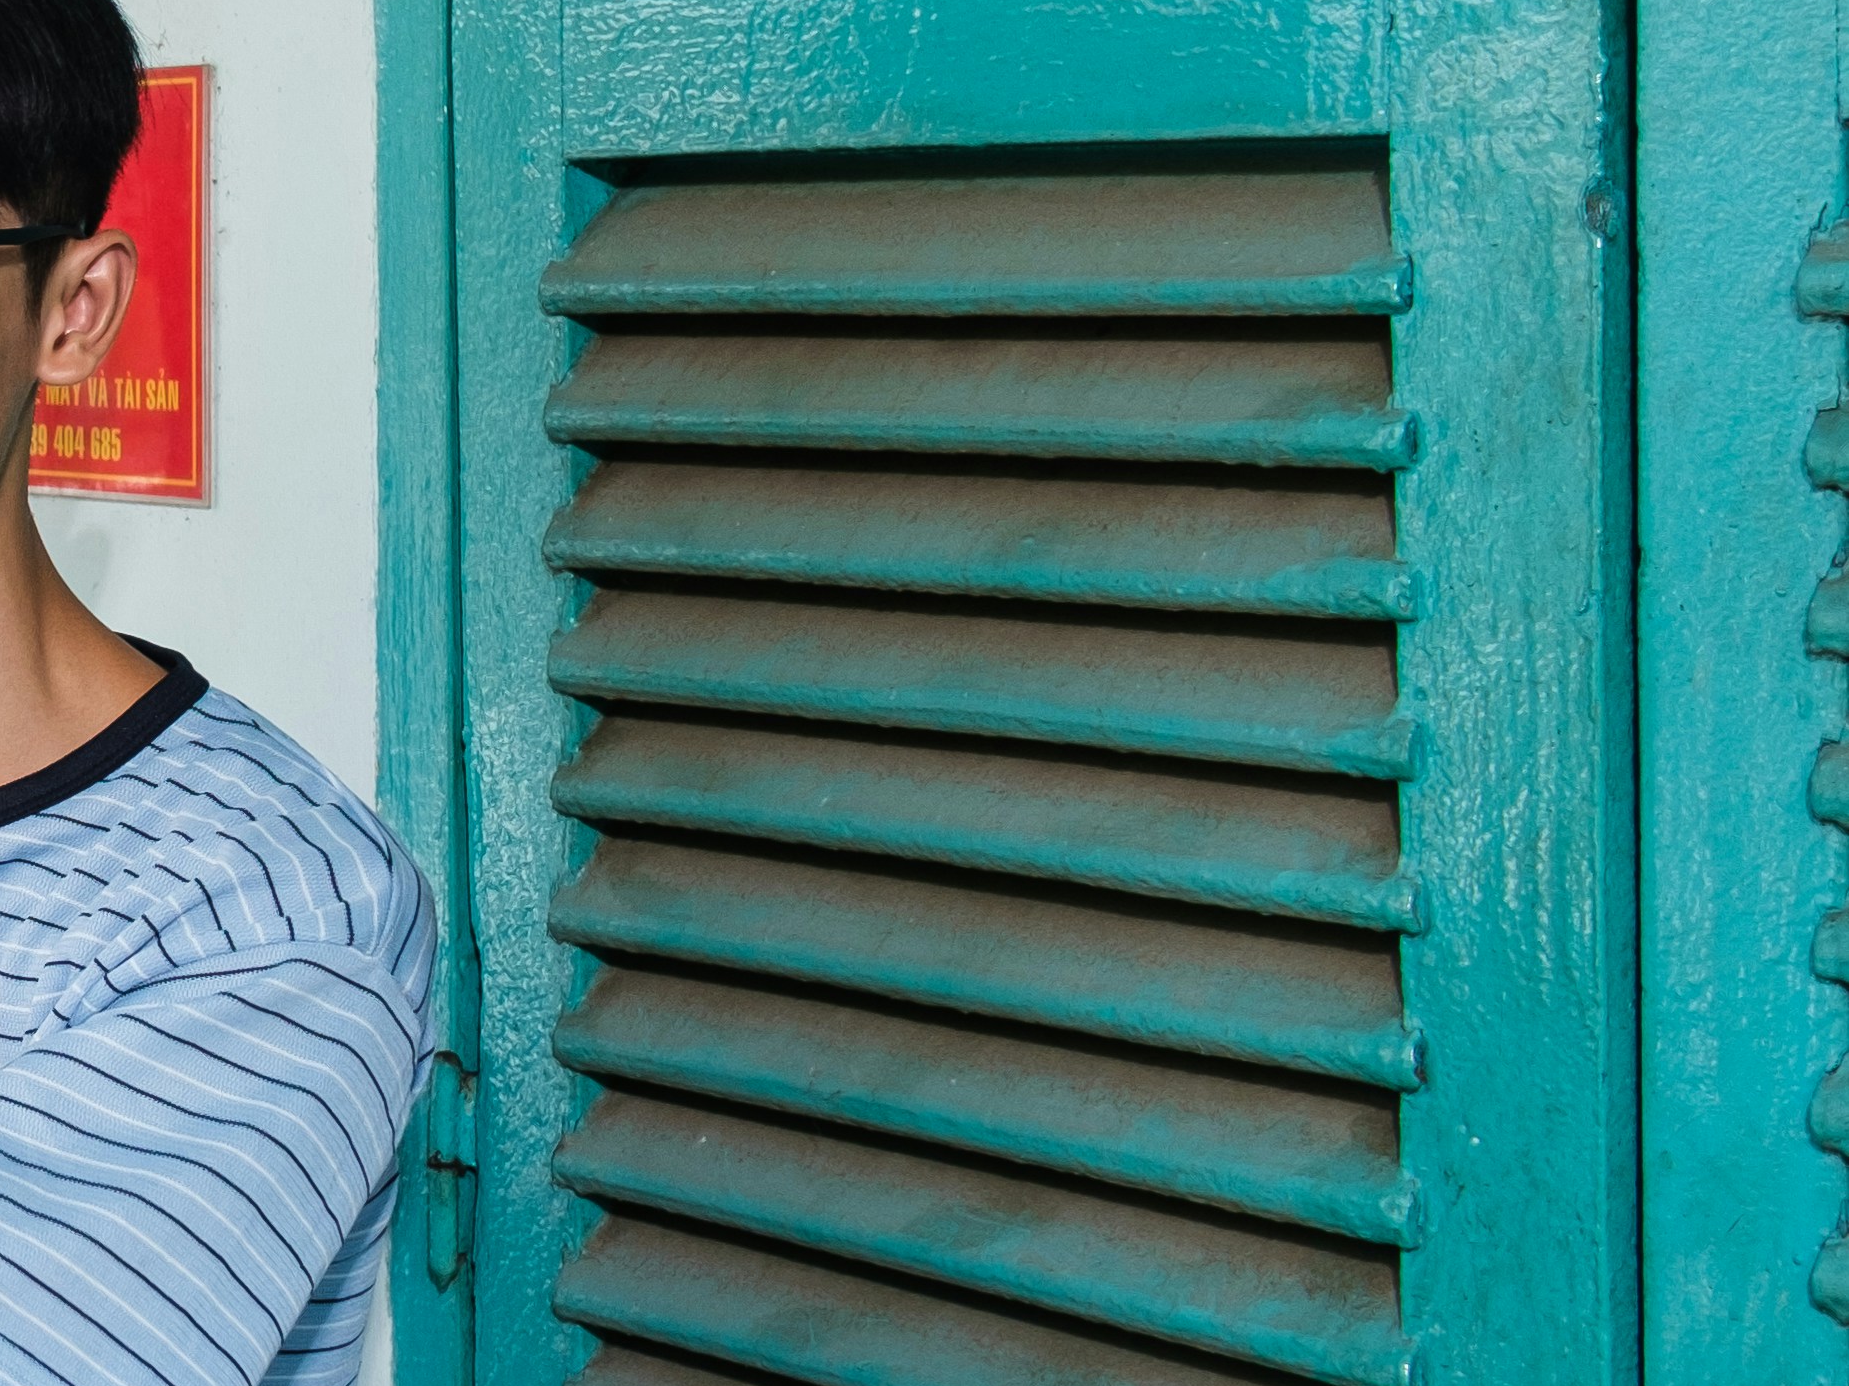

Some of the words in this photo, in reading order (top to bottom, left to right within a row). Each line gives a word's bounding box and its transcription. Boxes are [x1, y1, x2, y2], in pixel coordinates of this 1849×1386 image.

[88, 370, 108, 408] VÀ
[115, 371, 141, 410] TÀI
[145, 368, 179, 411] SẢN
[54, 425, 85, 459] 404
[91, 427, 121, 461] 685
